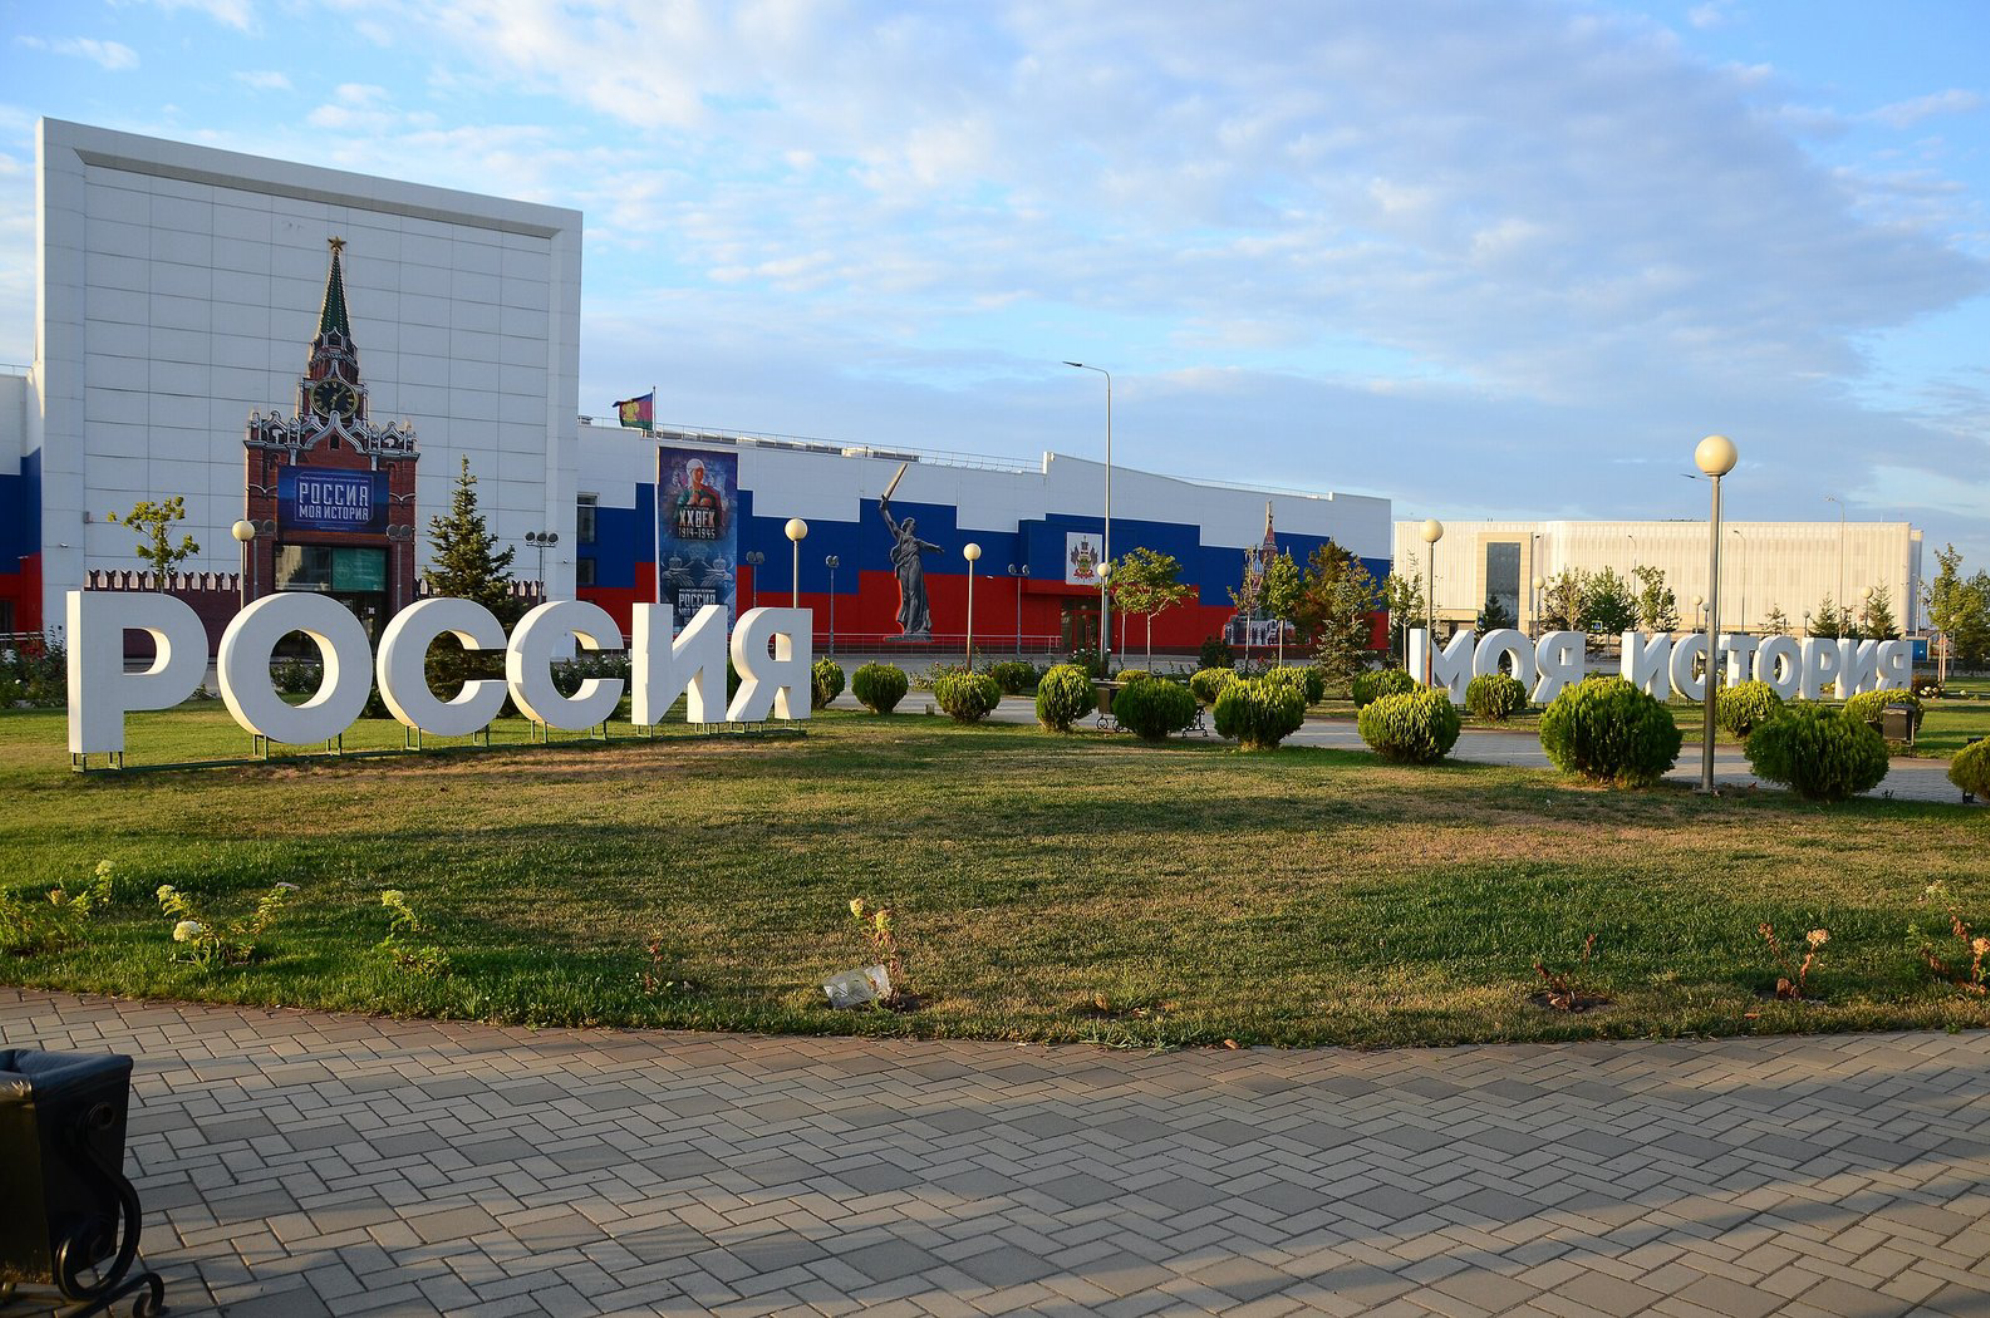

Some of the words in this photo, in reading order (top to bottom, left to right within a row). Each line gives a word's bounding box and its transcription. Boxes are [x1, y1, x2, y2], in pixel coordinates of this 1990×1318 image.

[300, 482, 369, 507] РОССИЯ
[300, 505, 322, 518] МОЯ
[324, 506, 370, 521] ИСТОРИЯ
[678, 593, 716, 607] РОССИЯ
[67, 590, 812, 753] РОССИЯ
[1409, 628, 1586, 704] МОЯ
[1620, 631, 1913, 700] ИСТОРИЯ
